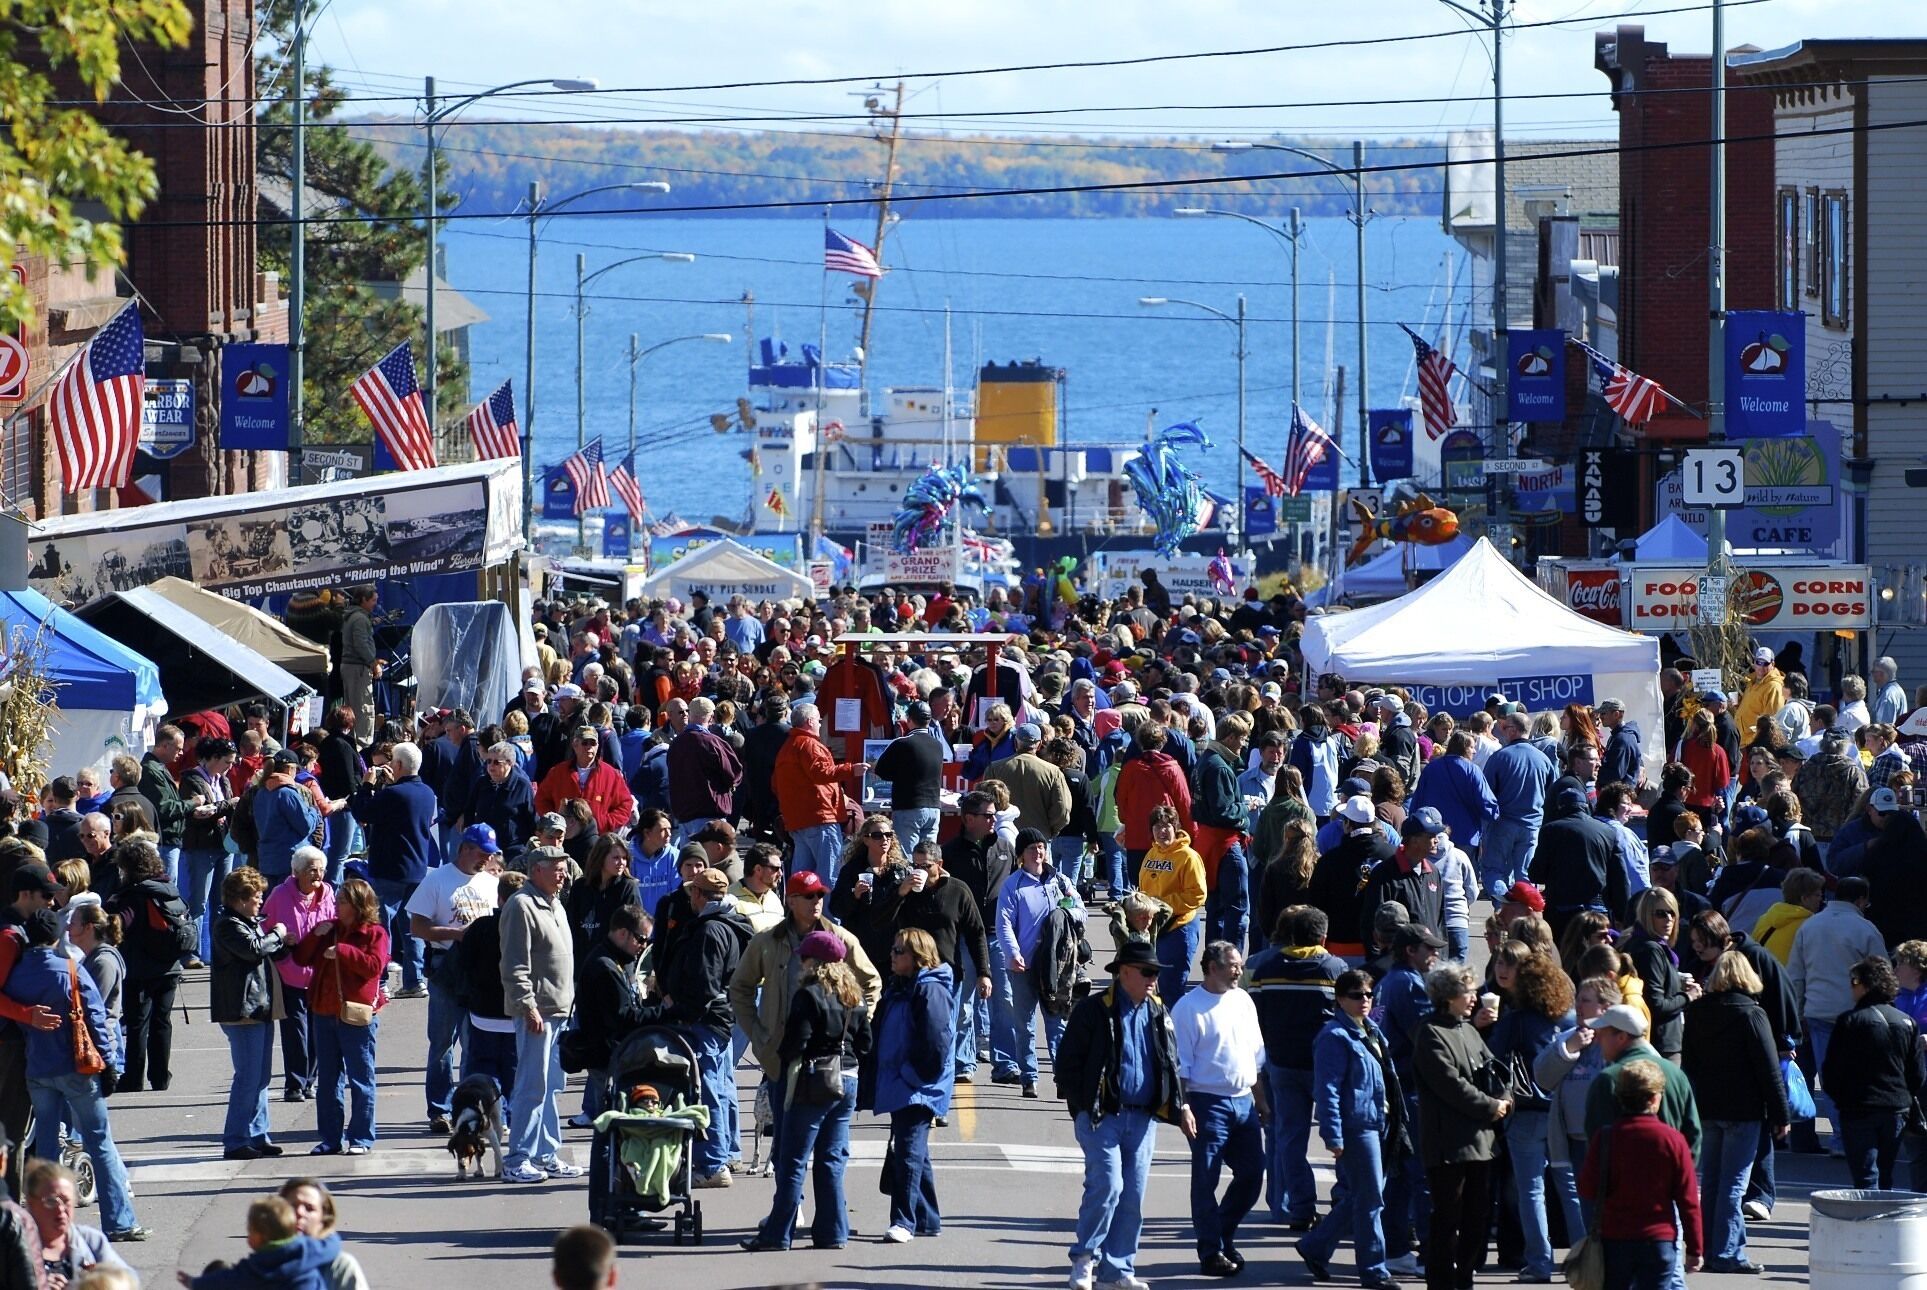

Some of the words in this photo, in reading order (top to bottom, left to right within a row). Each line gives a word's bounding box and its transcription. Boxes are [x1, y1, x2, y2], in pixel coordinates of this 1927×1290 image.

[144, 395, 190, 409] ARBOR
[1518, 392, 1554, 404] Welcome
[1740, 396, 1789, 412] Welcome
[146, 410, 183, 423] WEAR
[234, 415, 276, 429] Welcome
[308, 453, 345, 466] SECOND
[346, 458, 359, 467] ST
[1494, 462, 1527, 471] SECOND
[1519, 467, 1563, 492] NORTH
[1694, 459, 1737, 494] 13
[1752, 528, 1812, 543] CAFE
[900, 557, 940, 566] GRAND
[904, 566, 937, 574] PRIZE
[222, 587, 241, 599] Big
[243, 584, 263, 596] Top
[389, 565, 407, 576] the
[720, 584, 737, 594] PIE
[1645, 582, 1697, 596] FOO
[1792, 581, 1864, 594] CORN
[1700, 581, 1707, 593] 2
[1792, 602, 1866, 615] DOGS
[1441, 686, 1475, 706] TOP
[1529, 676, 1584, 702] SHOP
[1144, 859, 1173, 871] IOWA
